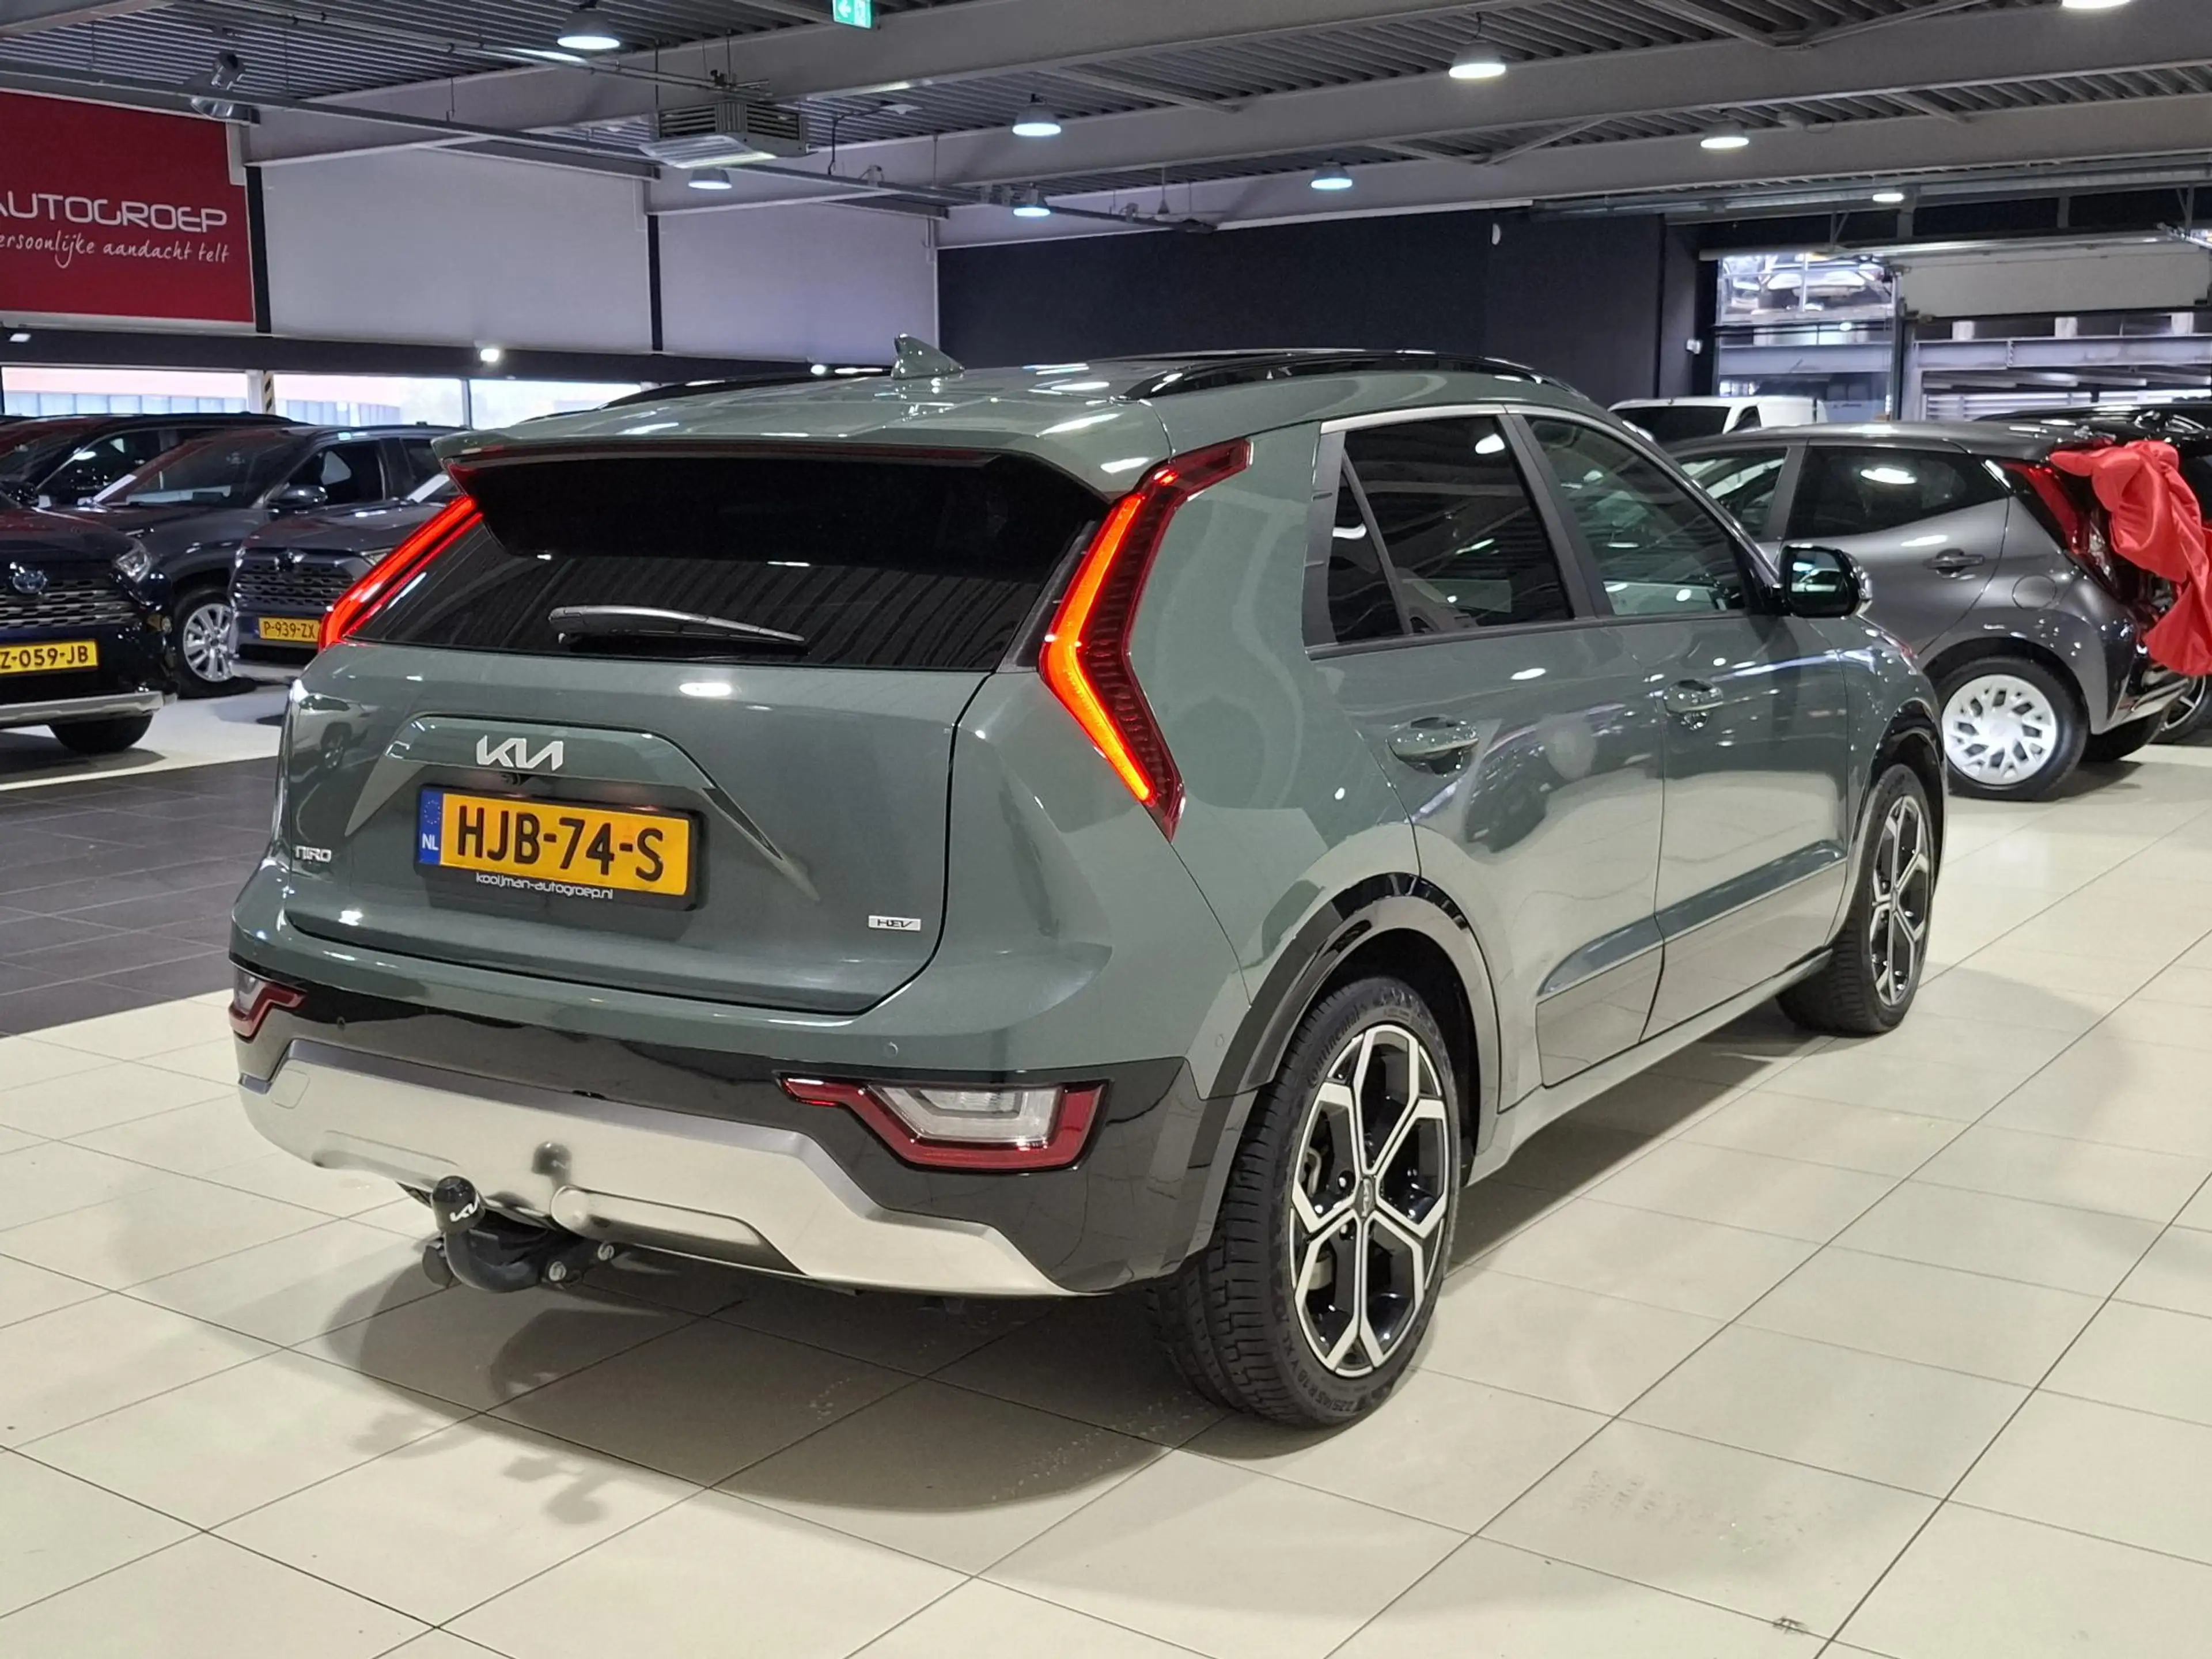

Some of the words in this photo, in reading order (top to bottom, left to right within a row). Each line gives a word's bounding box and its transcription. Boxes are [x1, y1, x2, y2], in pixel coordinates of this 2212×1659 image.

[103, 238, 192, 260] aandacht
[198, 241, 229, 263] telt
[263, 621, 316, 638] P-939-ZX
[476, 734, 564, 771] KIA
[422, 832, 440, 851] NL
[457, 805, 664, 882] HJB-74-S
[475, 872, 613, 899] kooijman-autogroep.nl
[877, 919, 914, 928] HEV
